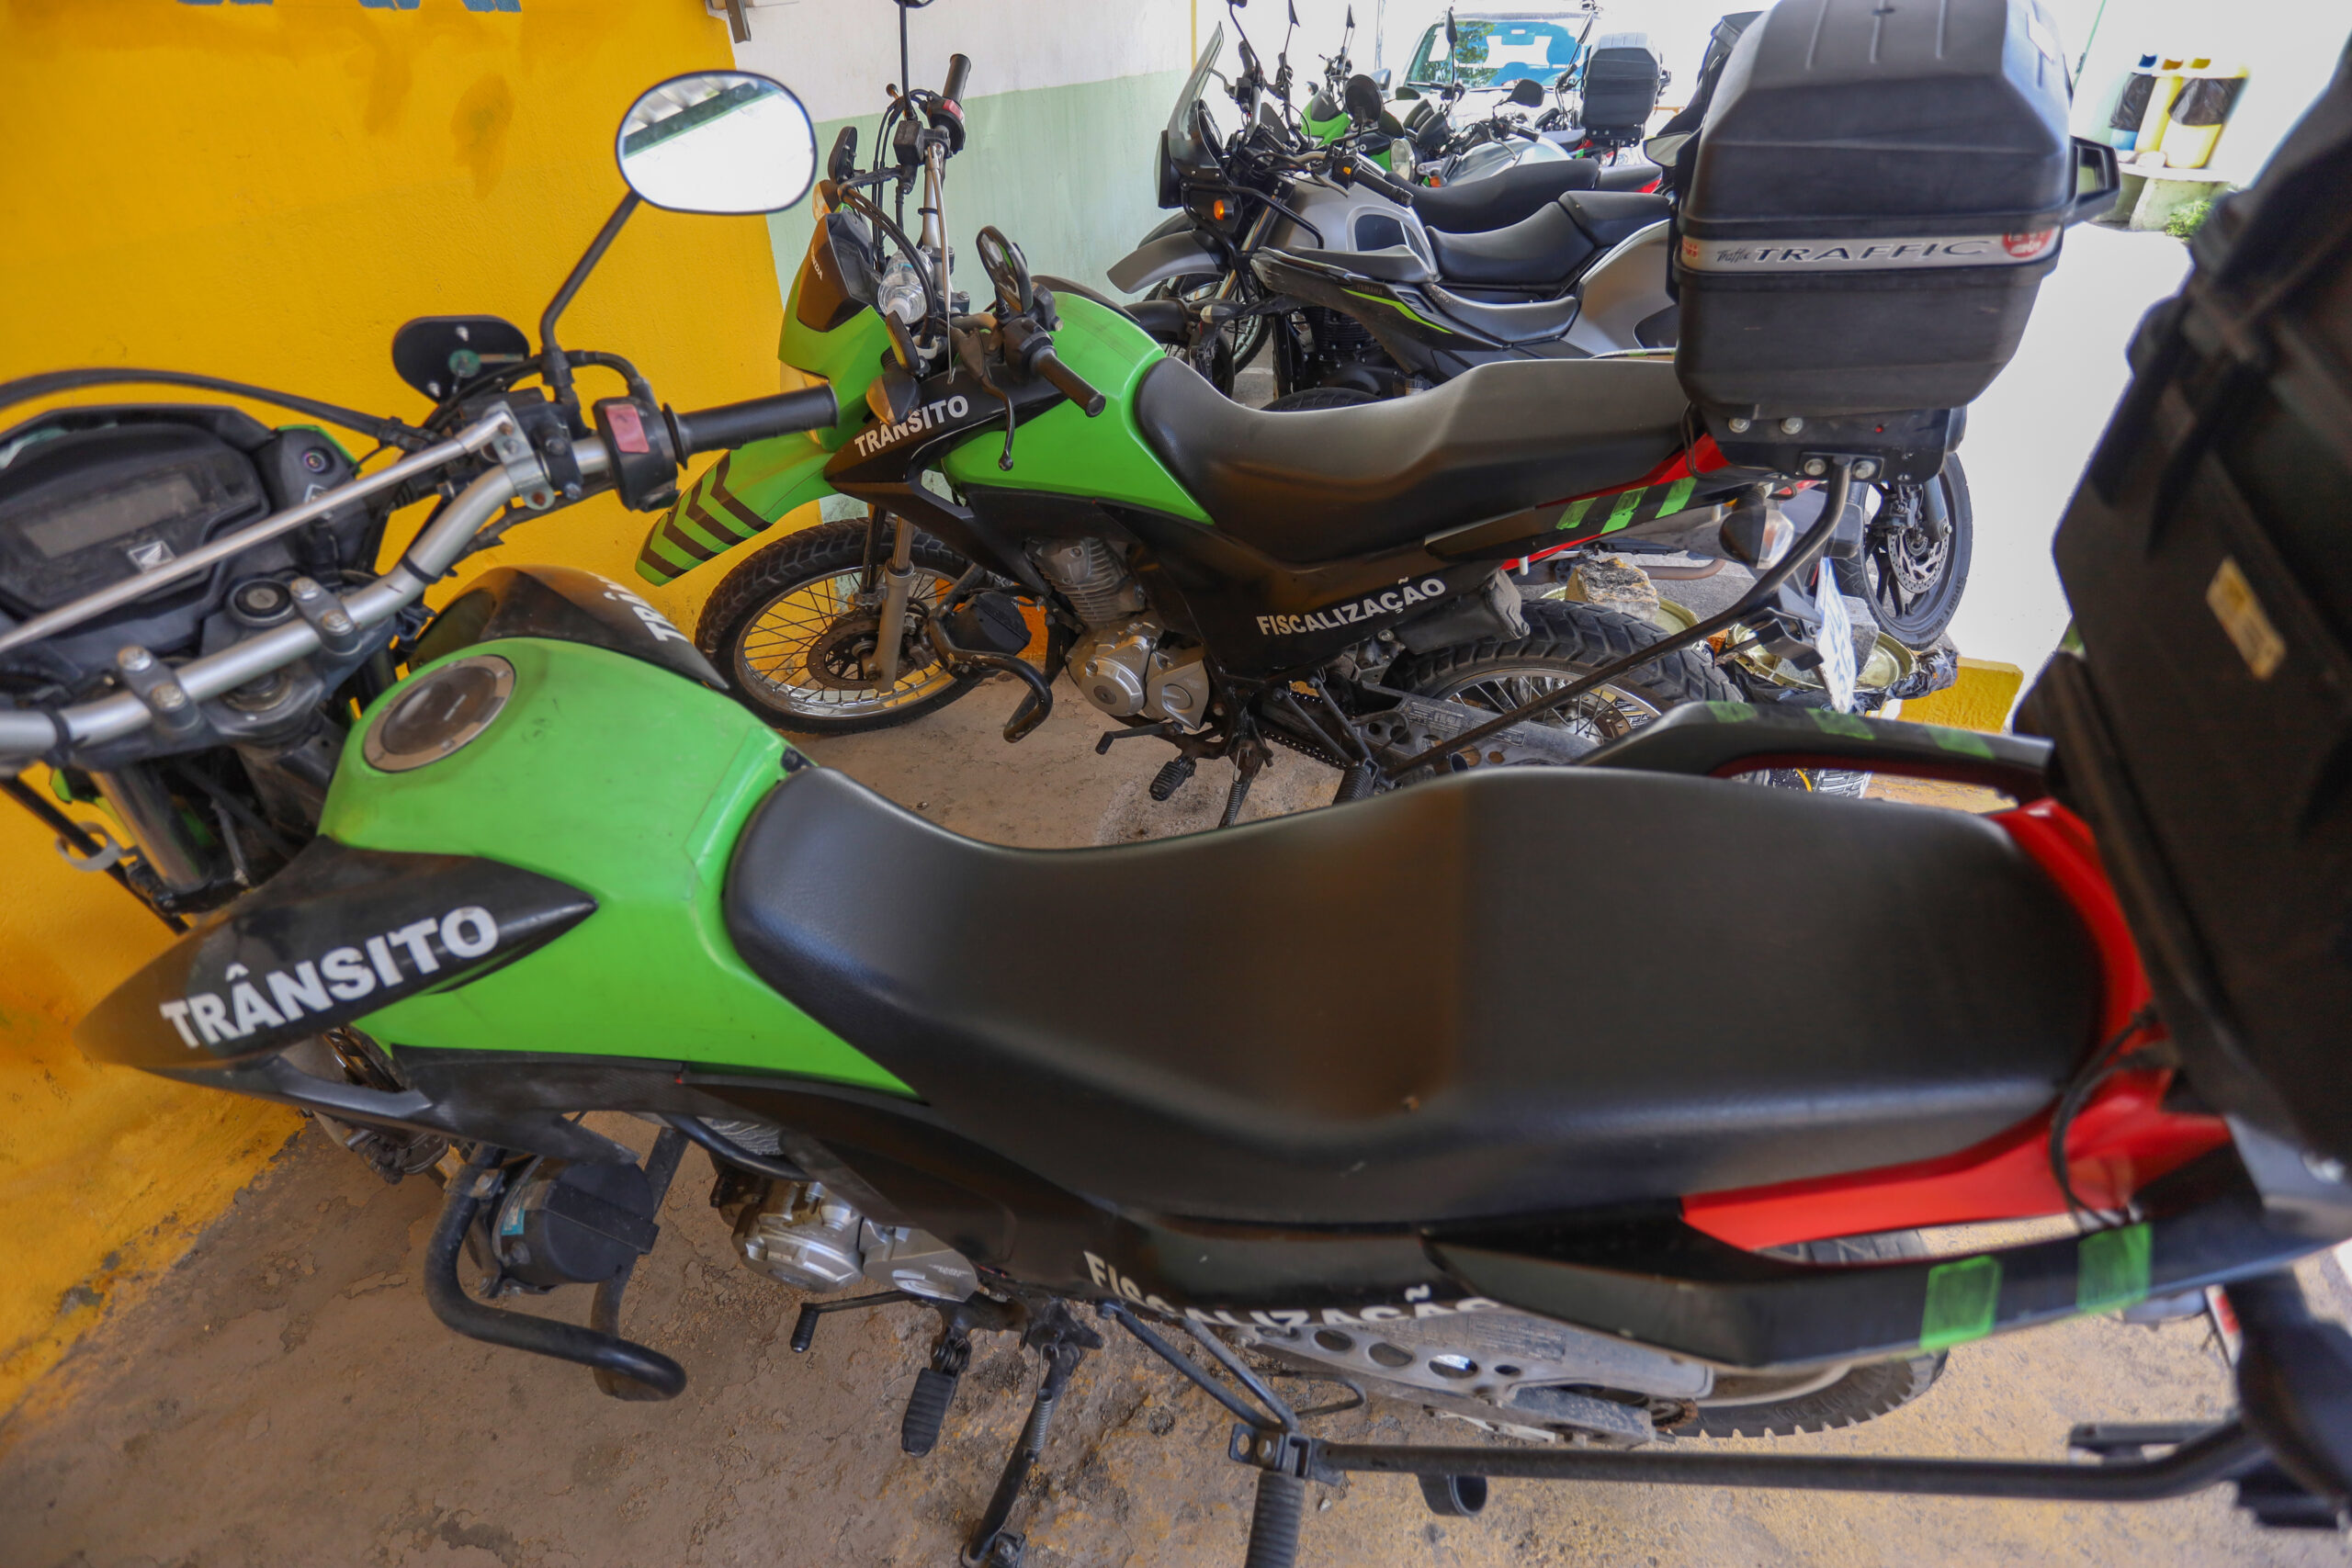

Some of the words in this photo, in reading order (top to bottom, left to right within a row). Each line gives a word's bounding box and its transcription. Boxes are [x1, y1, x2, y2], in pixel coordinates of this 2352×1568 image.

[1754, 240, 1995, 265] TRAFFIC
[1256, 576, 1446, 636] FISCALIZAÇÃO
[160, 906, 500, 1049] TRÂNSITO
